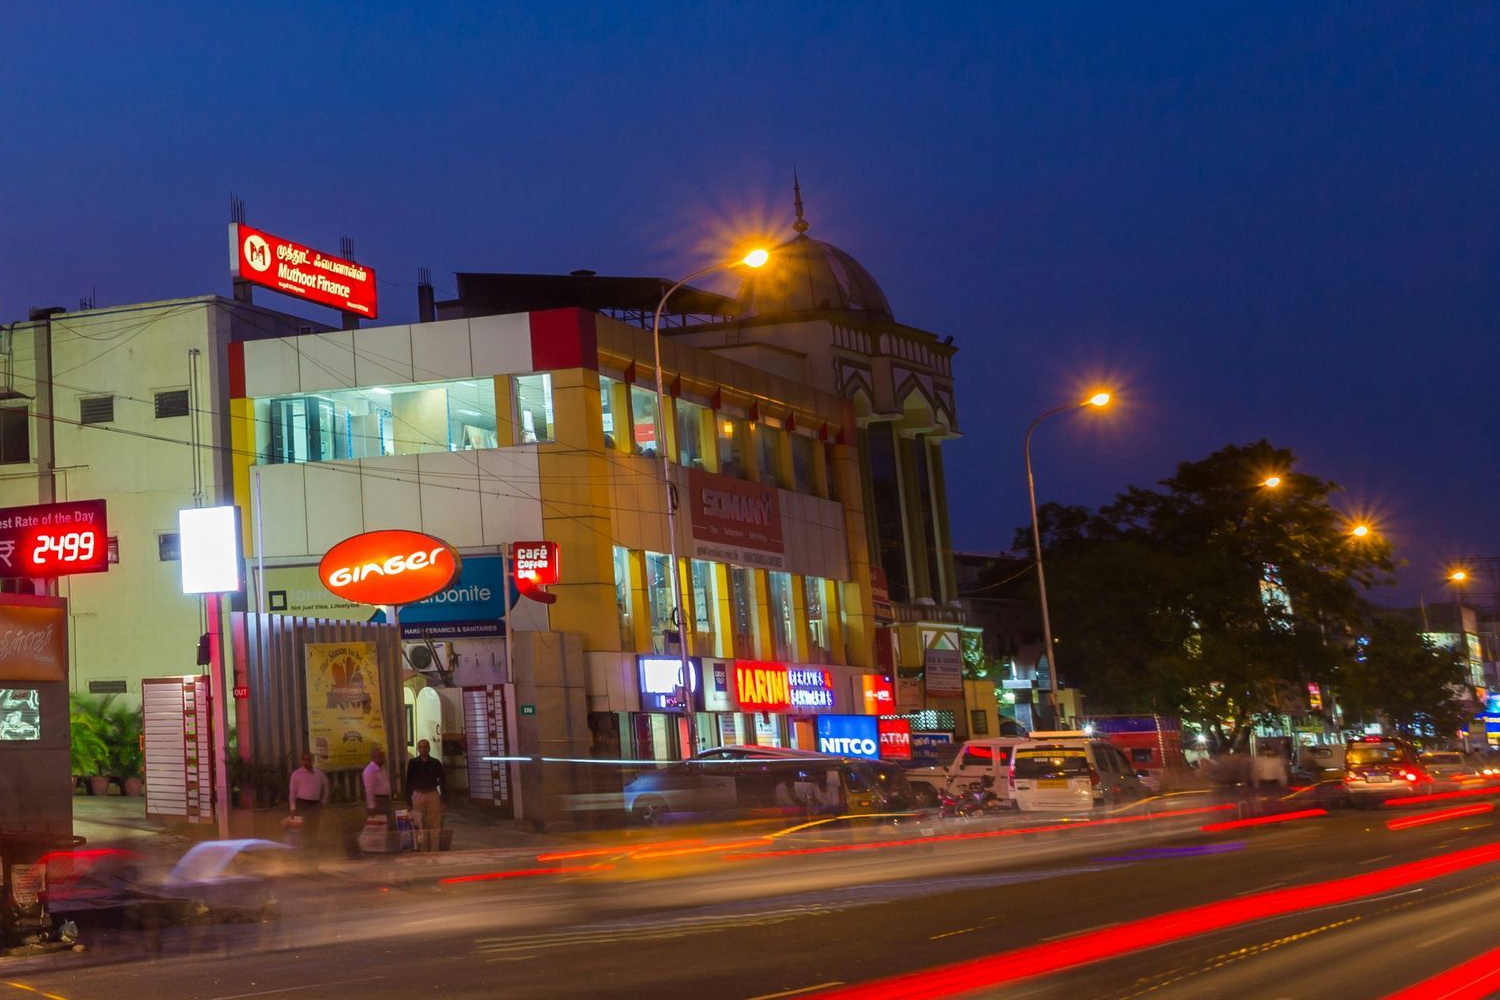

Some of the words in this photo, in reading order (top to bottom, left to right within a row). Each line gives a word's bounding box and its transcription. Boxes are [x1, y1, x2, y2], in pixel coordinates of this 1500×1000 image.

[277, 262, 317, 288] Muthoot
[317, 274, 350, 299] Finance
[15, 516, 39, 528] Rate
[41, 513, 52, 525] of
[54, 512, 71, 524] the
[74, 511, 94, 524] Day
[33, 531, 95, 564] 2499
[425, 626, 455, 634] CERAMICS
[234, 688, 248, 697] OUT
[820, 737, 877, 755] NITCO
[880, 732, 910, 745] ATM
